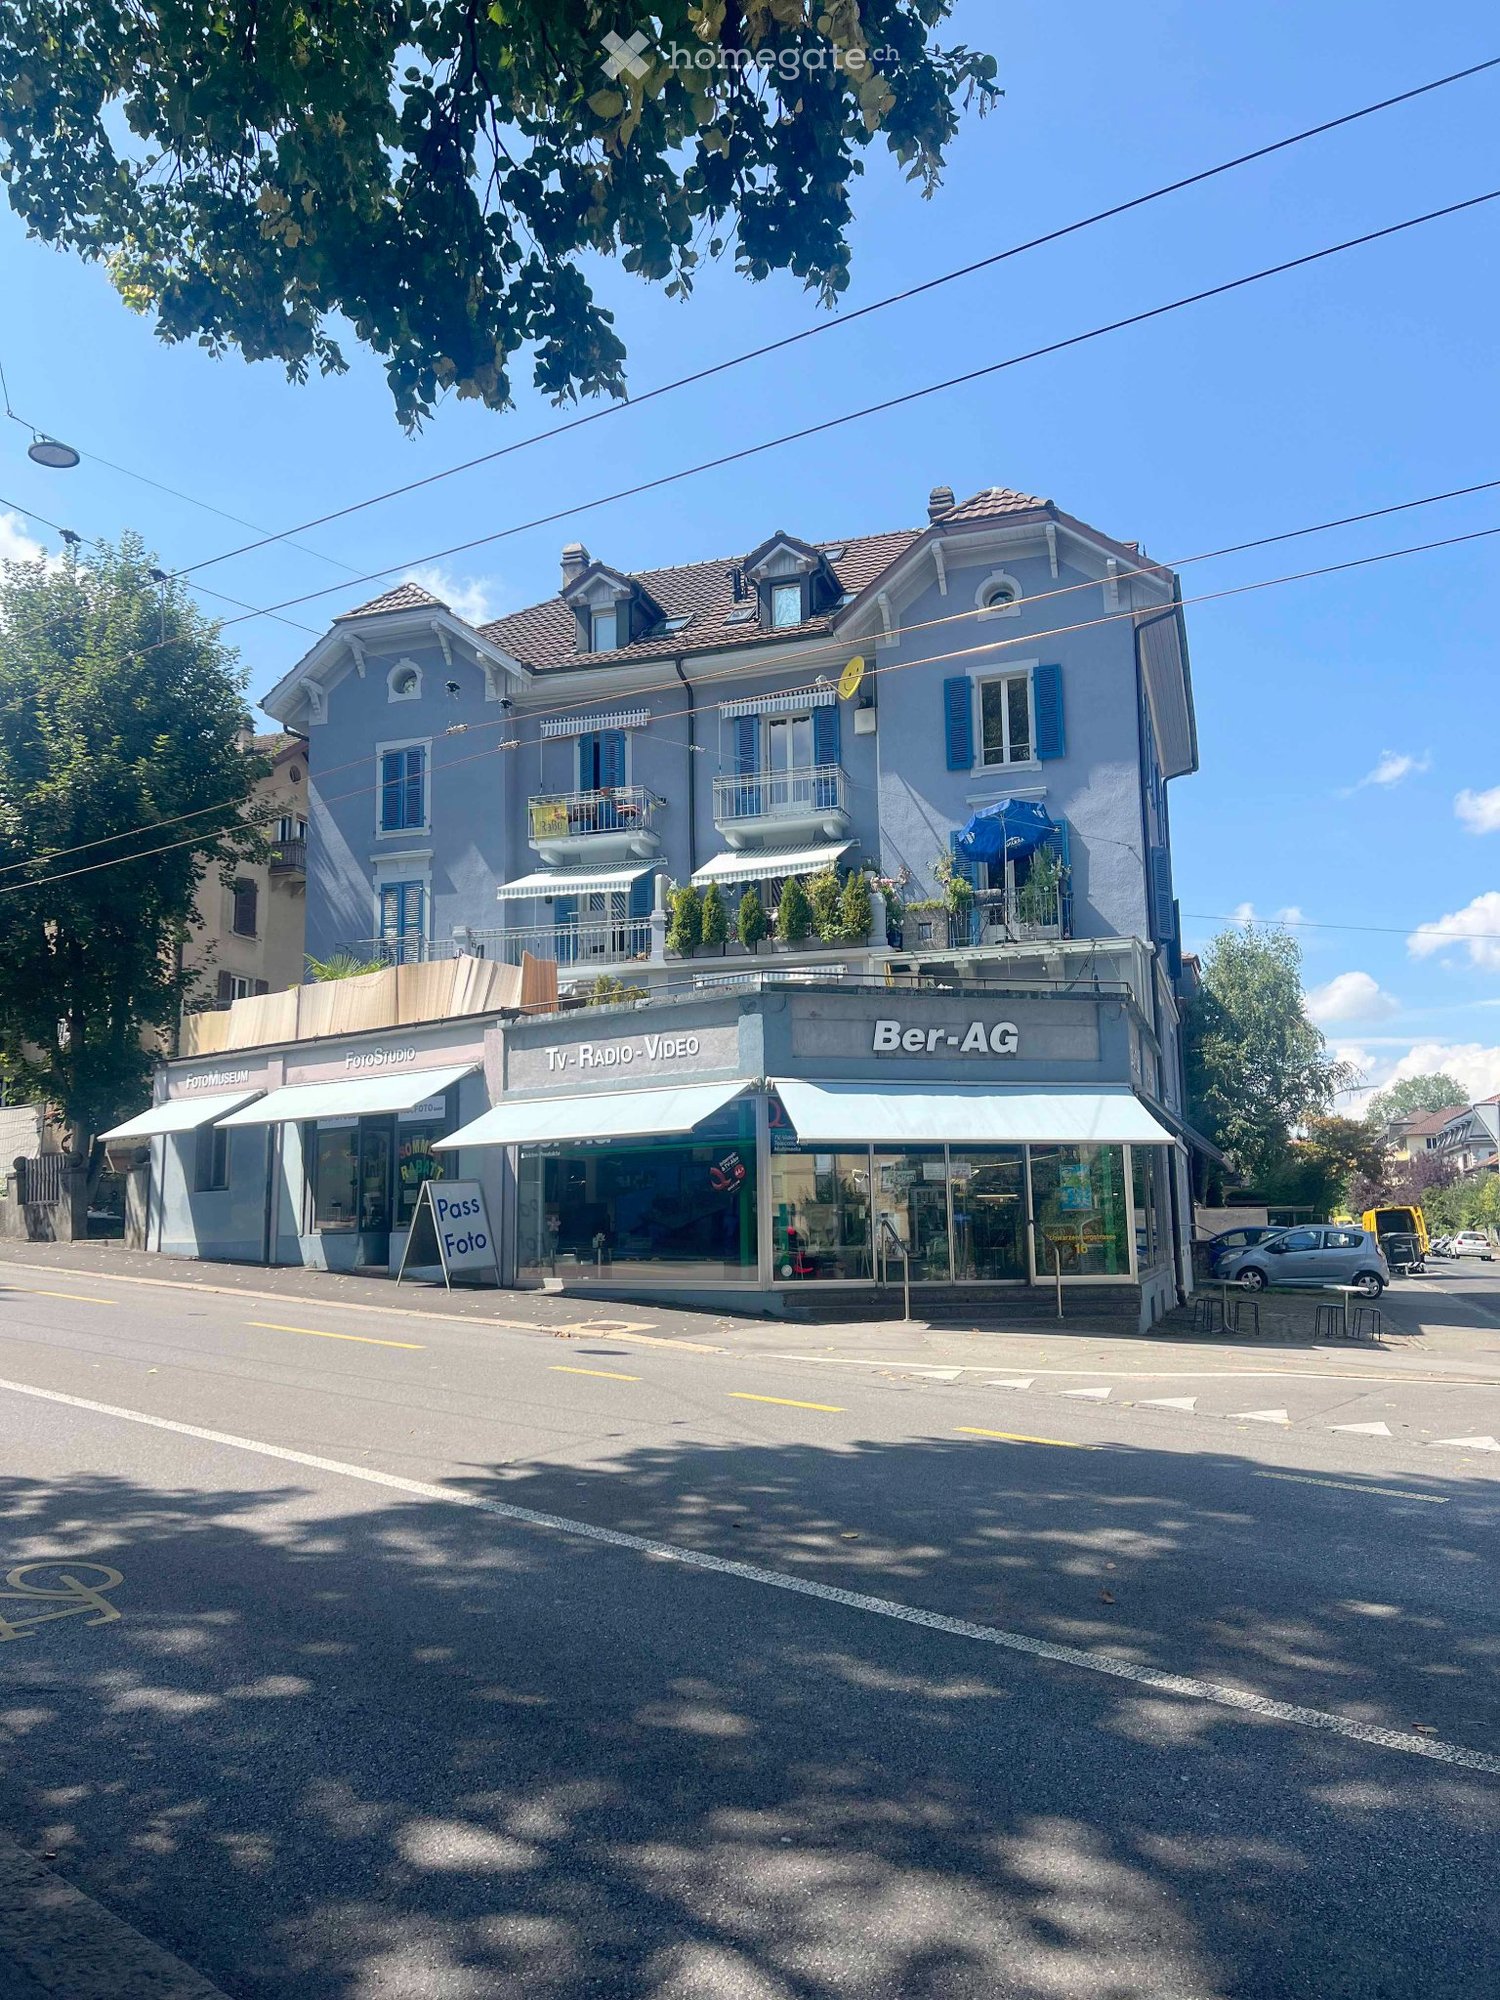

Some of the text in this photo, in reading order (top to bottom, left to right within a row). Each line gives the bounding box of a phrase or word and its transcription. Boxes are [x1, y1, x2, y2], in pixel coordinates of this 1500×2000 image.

[873, 1020, 1019, 1053] Ber-AG
[437, 1199, 480, 1221] Pass
[444, 1232, 487, 1257] Foto
